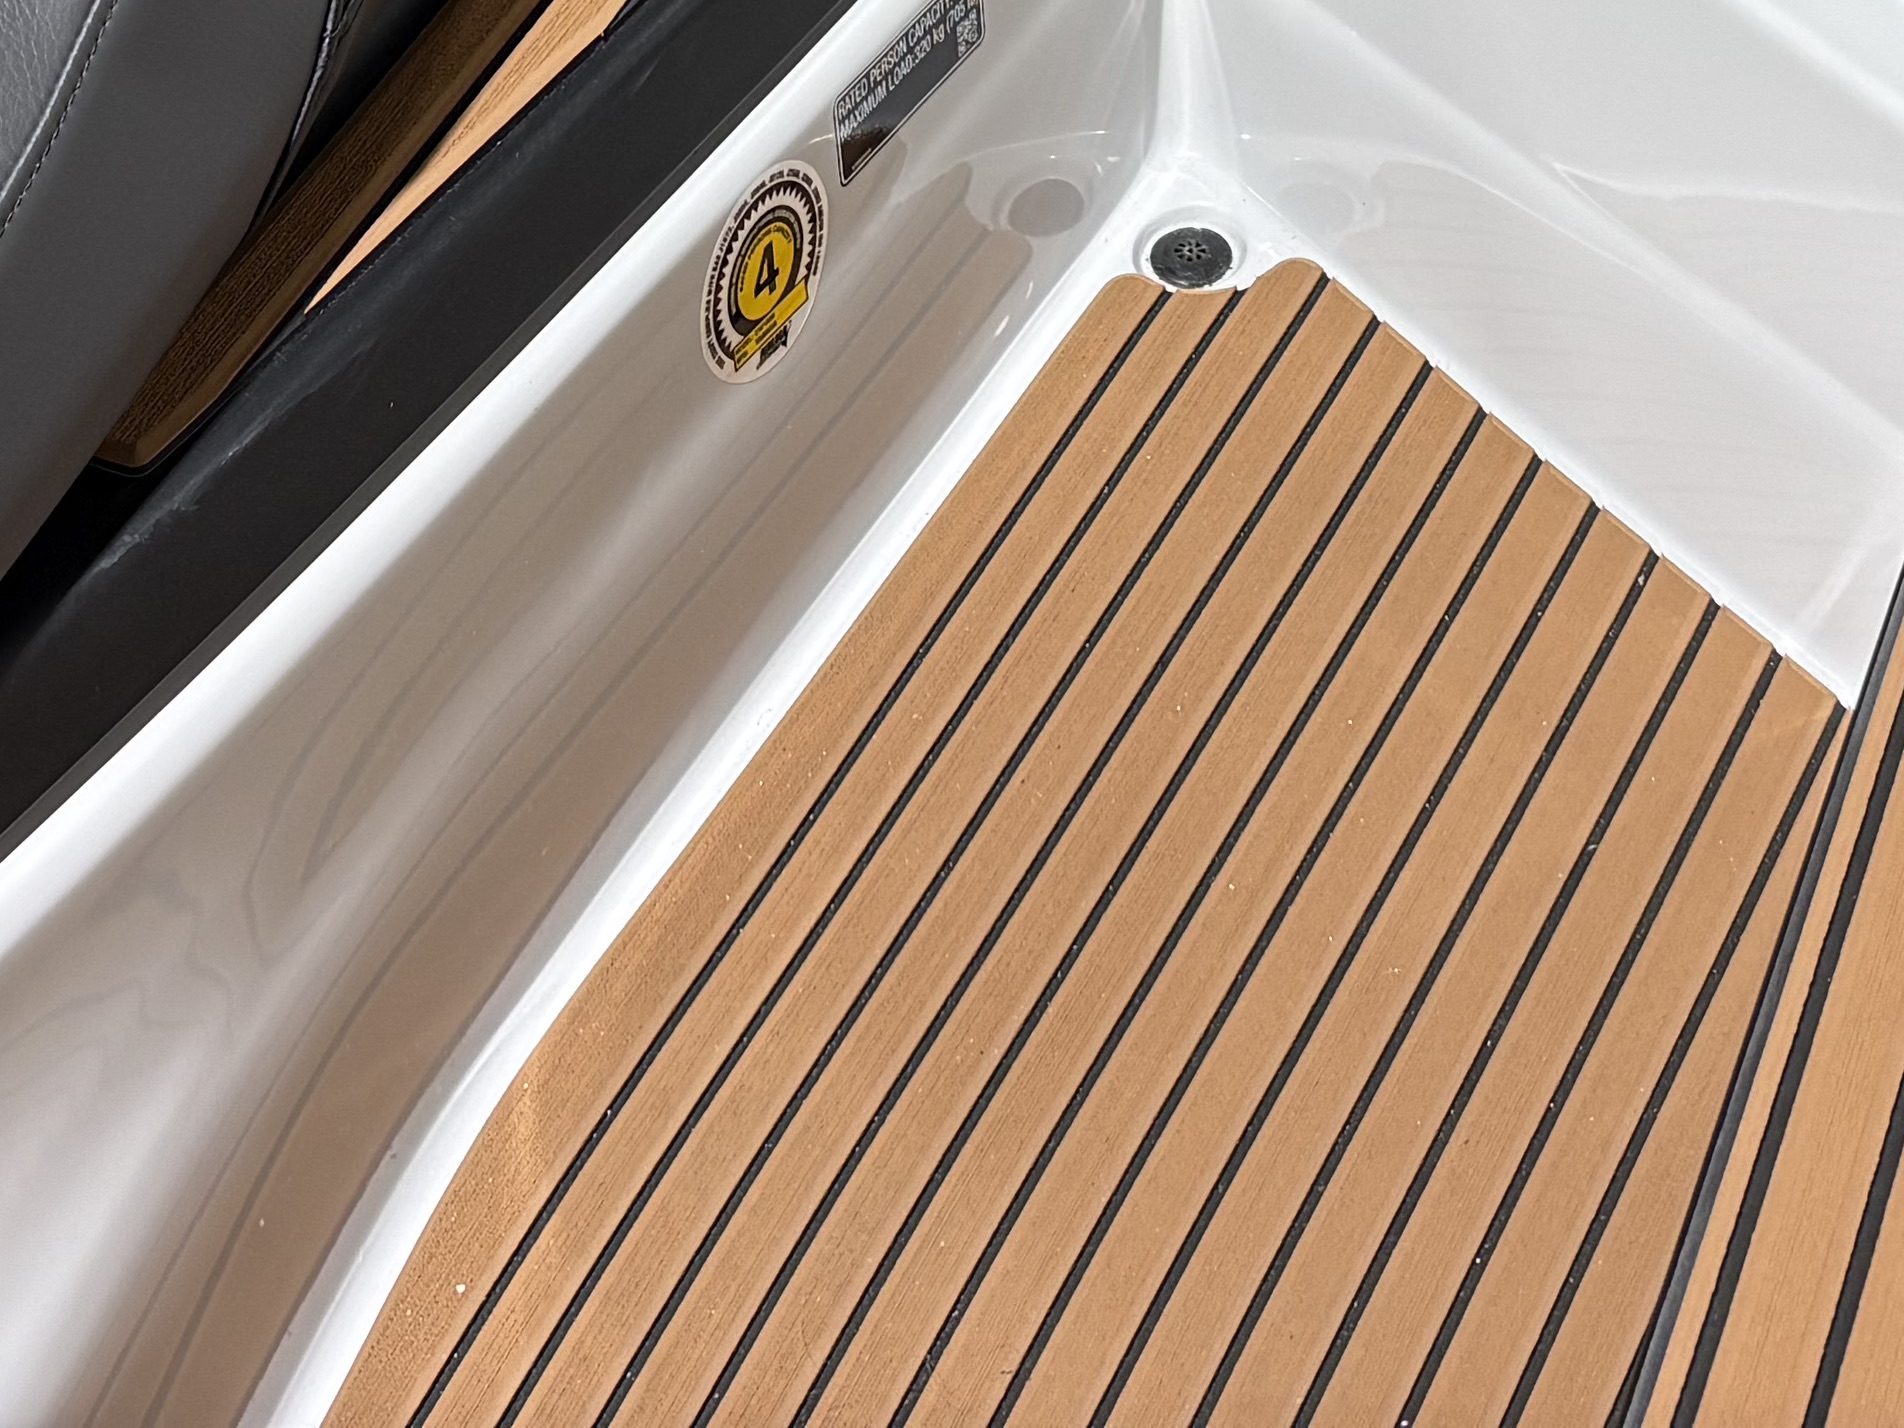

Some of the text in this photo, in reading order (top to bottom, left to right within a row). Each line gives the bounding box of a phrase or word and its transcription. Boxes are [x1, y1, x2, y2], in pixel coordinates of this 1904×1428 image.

[838, 79, 868, 119] RATED
[870, 38, 907, 87] PERSON
[839, 81, 887, 142] MAXIMUM
[932, 23, 944, 45] kg
[946, 1, 965, 34] (705
[754, 240, 779, 298] 4
